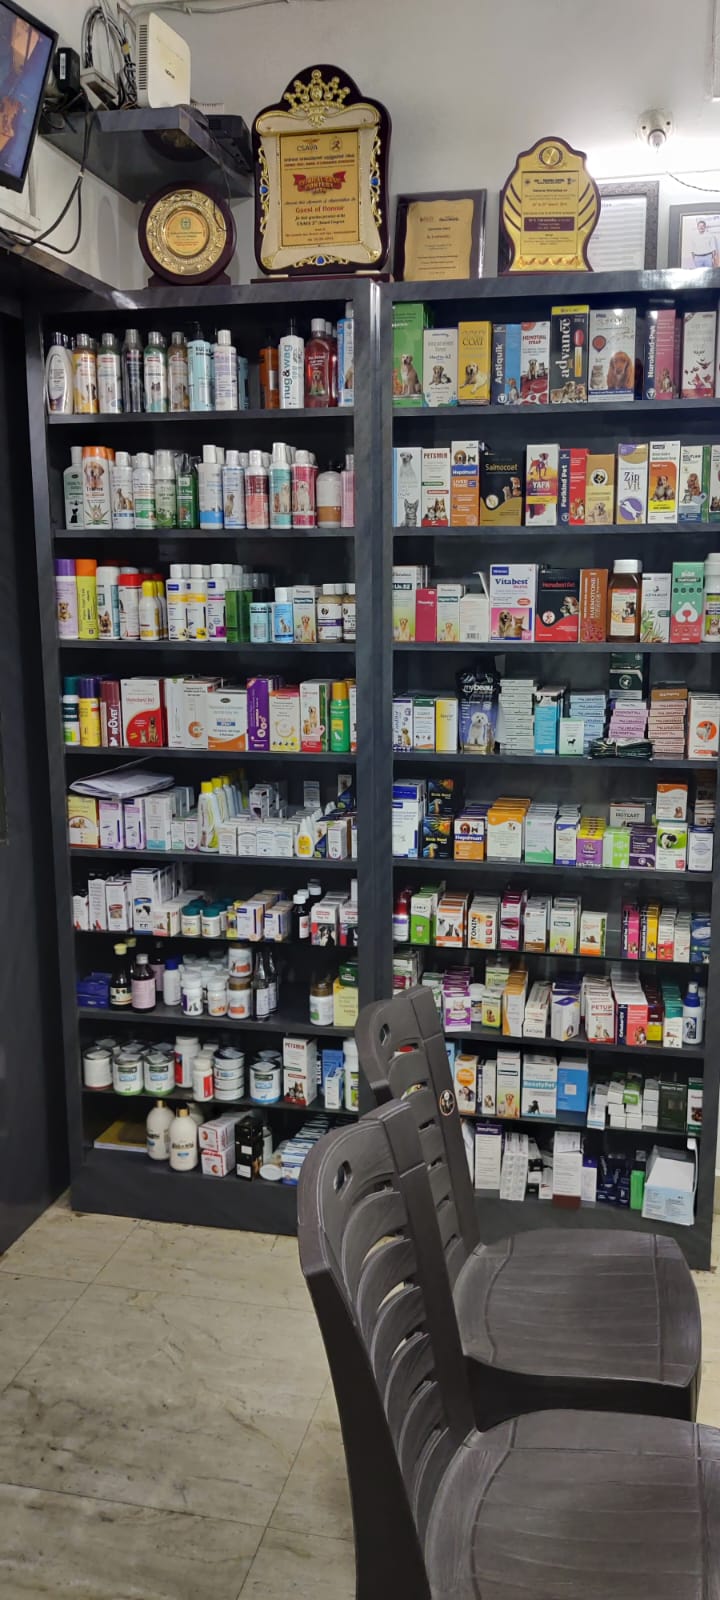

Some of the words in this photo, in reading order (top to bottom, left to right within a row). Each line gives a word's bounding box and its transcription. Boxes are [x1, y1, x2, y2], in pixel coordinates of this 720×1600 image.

[495, 343, 504, 384] Aptiquik
[555, 317, 572, 379] advance
[485, 463, 518, 472] Salmocoat
